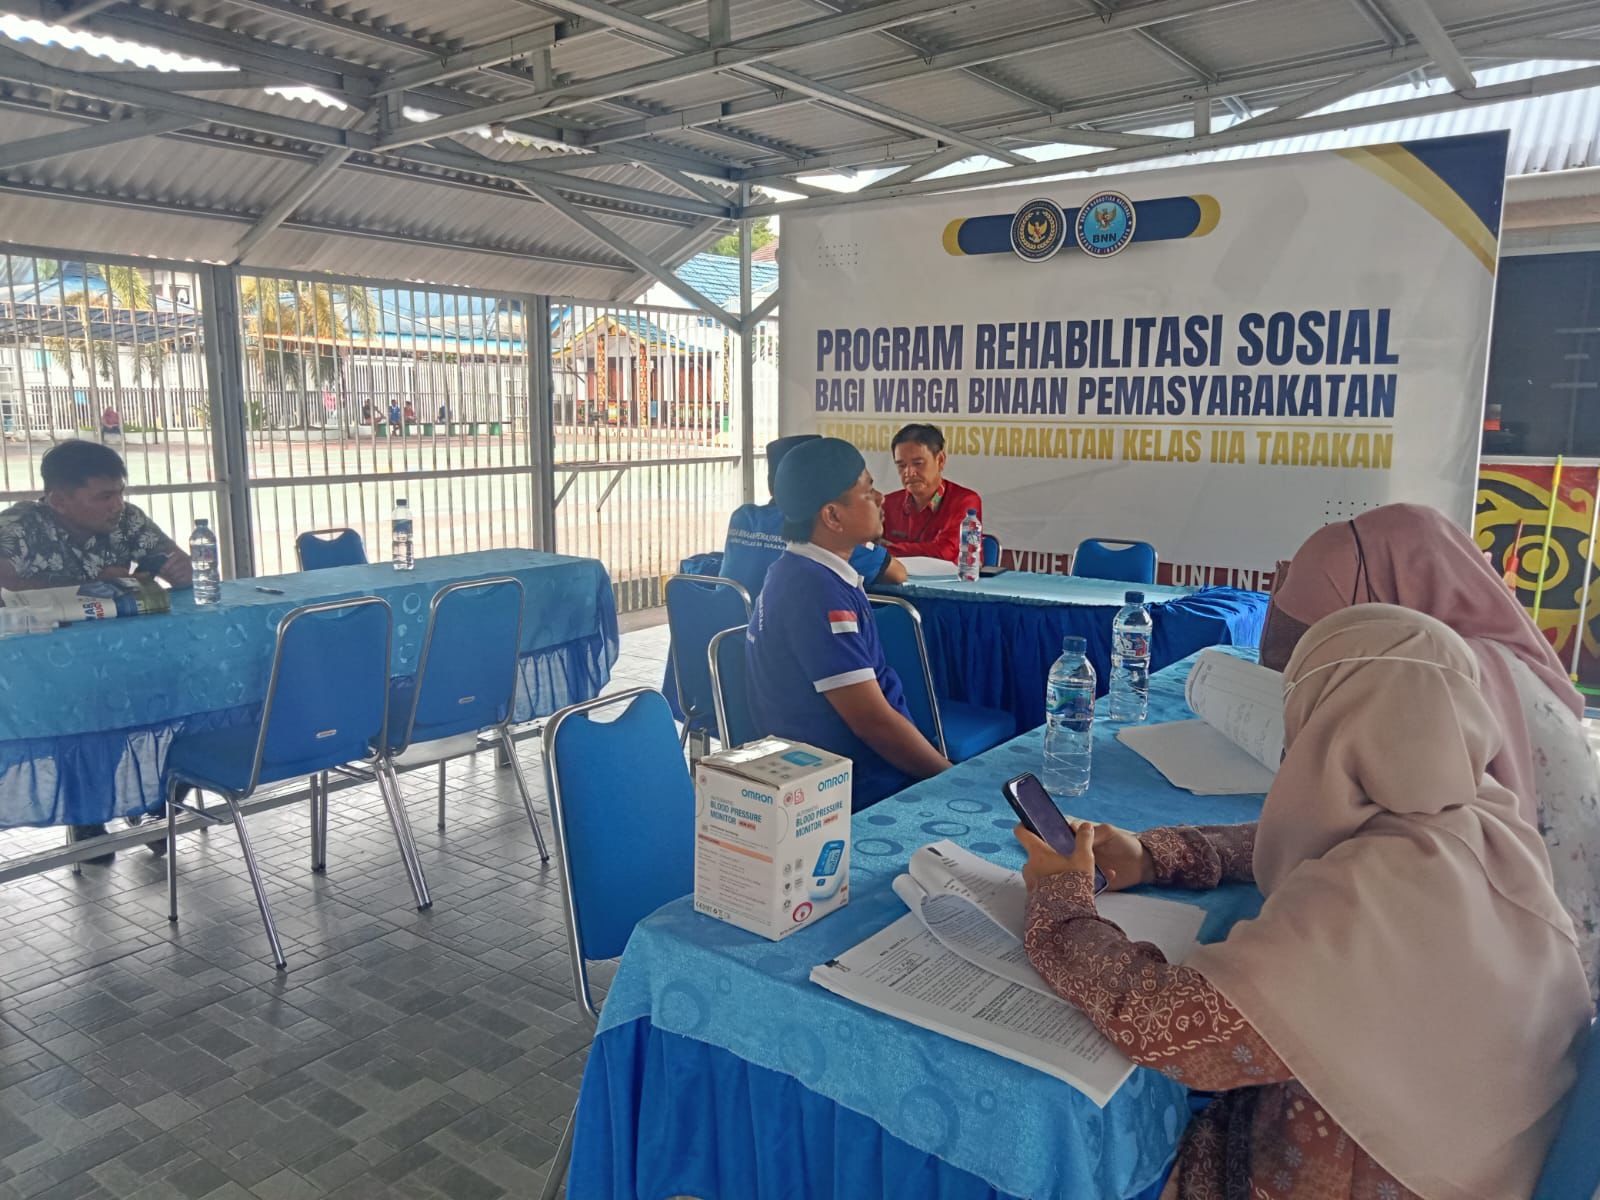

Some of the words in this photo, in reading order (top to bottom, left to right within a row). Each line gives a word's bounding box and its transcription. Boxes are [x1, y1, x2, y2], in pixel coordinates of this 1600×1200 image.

[1092, 232, 1117, 244] BNN
[815, 324, 964, 372] PROGRAM
[975, 314, 1224, 370] REHABILITASI
[1237, 308, 1400, 367] SOSIAL
[815, 378, 865, 412] BAGI
[873, 378, 960, 414] WARGA
[968, 376, 1068, 415] BINAAN
[1077, 374, 1398, 418] PEMASYARAKATAN
[1122, 428, 1202, 463] KELAS
[1210, 430, 1246, 465] IIA
[1256, 431, 1394, 470] TARAKAN
[710, 800, 730, 813] BLOOD
[730, 806, 762, 823] PRESSURE
[710, 809, 737, 825] MONITOR
[796, 812, 816, 828] BLOOD
[816, 801, 843, 819] PRESSURE
[796, 820, 822, 838] MONITOR
